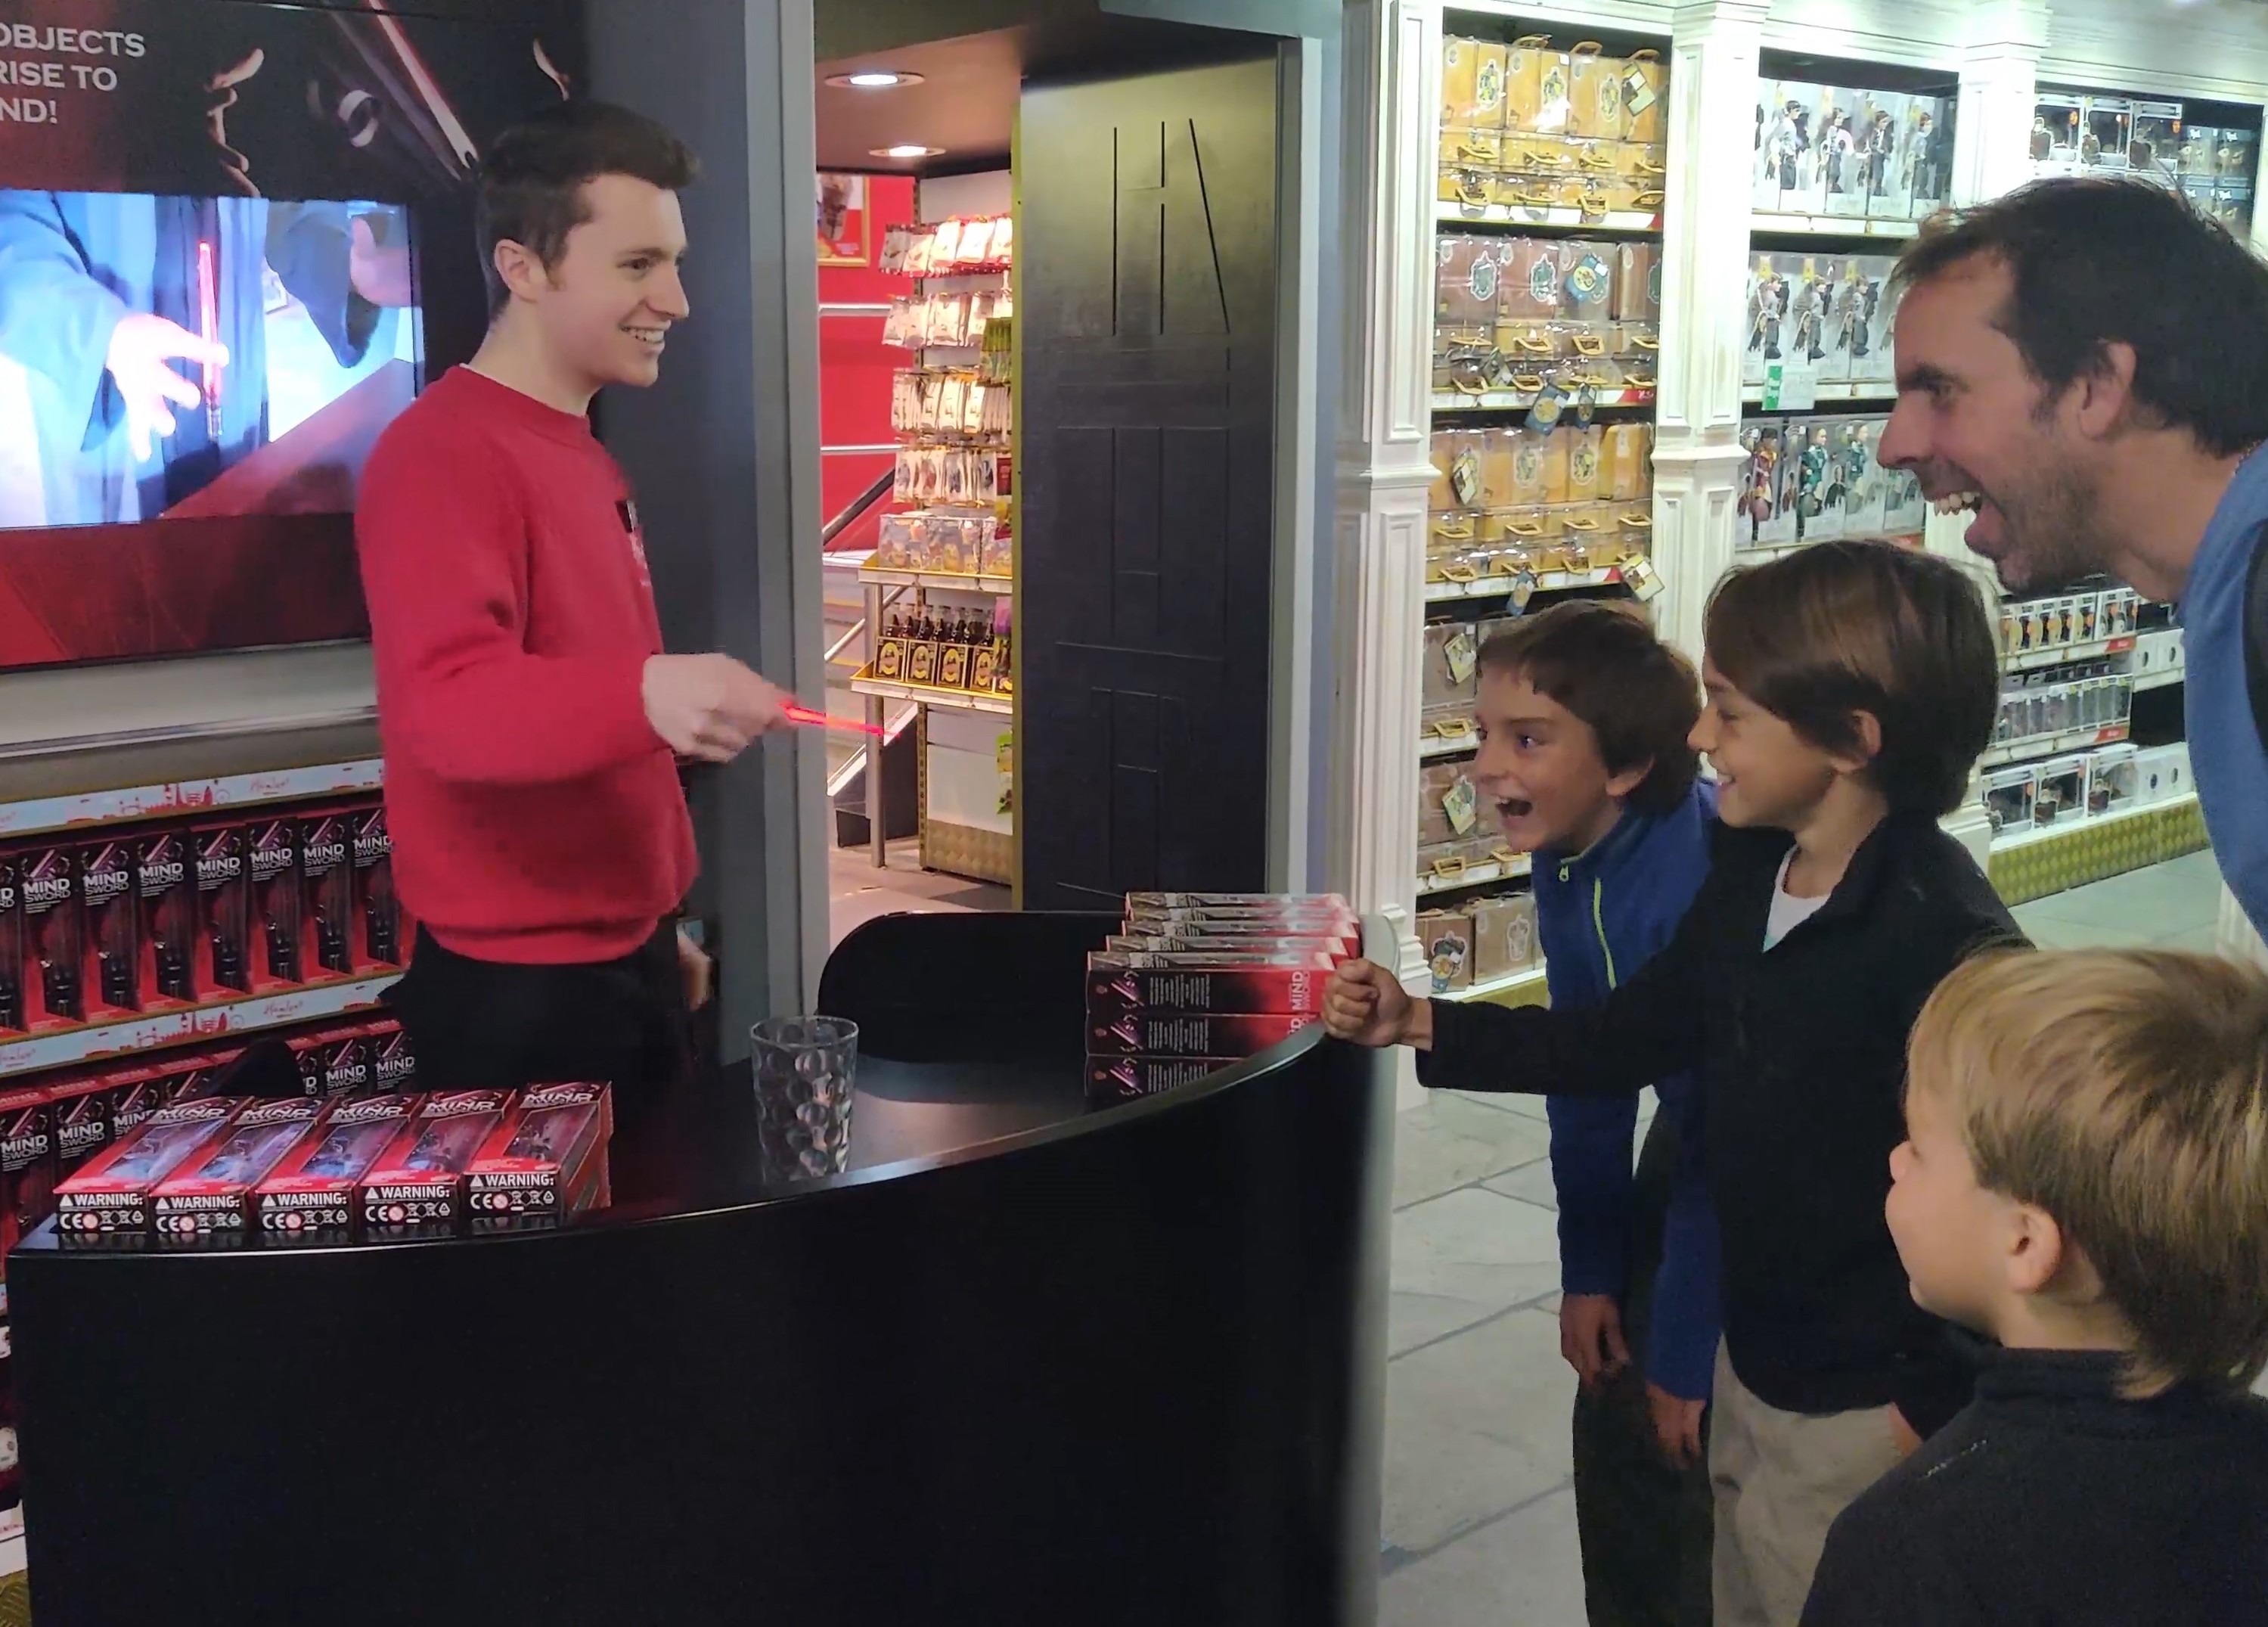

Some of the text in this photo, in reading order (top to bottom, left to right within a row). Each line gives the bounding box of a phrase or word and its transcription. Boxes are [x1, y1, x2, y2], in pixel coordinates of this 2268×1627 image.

[70, 64, 118, 92] TO
[353, 834, 392, 851] MIND
[250, 848, 293, 864] MIND
[303, 843, 344, 859] MIND
[138, 862, 183, 878] MIND
[196, 857, 240, 872] MIND
[22, 878, 70, 895] MIND
[82, 871, 129, 887] MIND
[1292, 971, 1303, 1011] MIND
[375, 1056, 415, 1073] MIND
[325, 1065, 366, 1082] MIND
[113, 1110, 154, 1127] MIN
[57, 1122, 104, 1140] MIND
[0, 1135, 48, 1153] MIND
[486, 1173, 554, 1187] WARNING:
[74, 1193, 143, 1206] WARNING:
[277, 1192, 347, 1206] WARNING:
[380, 1185, 450, 1199] WARNING:
[171, 1196, 240, 1209] WARNING:
[470, 1193, 493, 1209] CE
[60, 1212, 84, 1230] CE
[262, 1212, 286, 1230] CE
[365, 1206, 389, 1222] CE
[156, 1216, 180, 1232] CE
